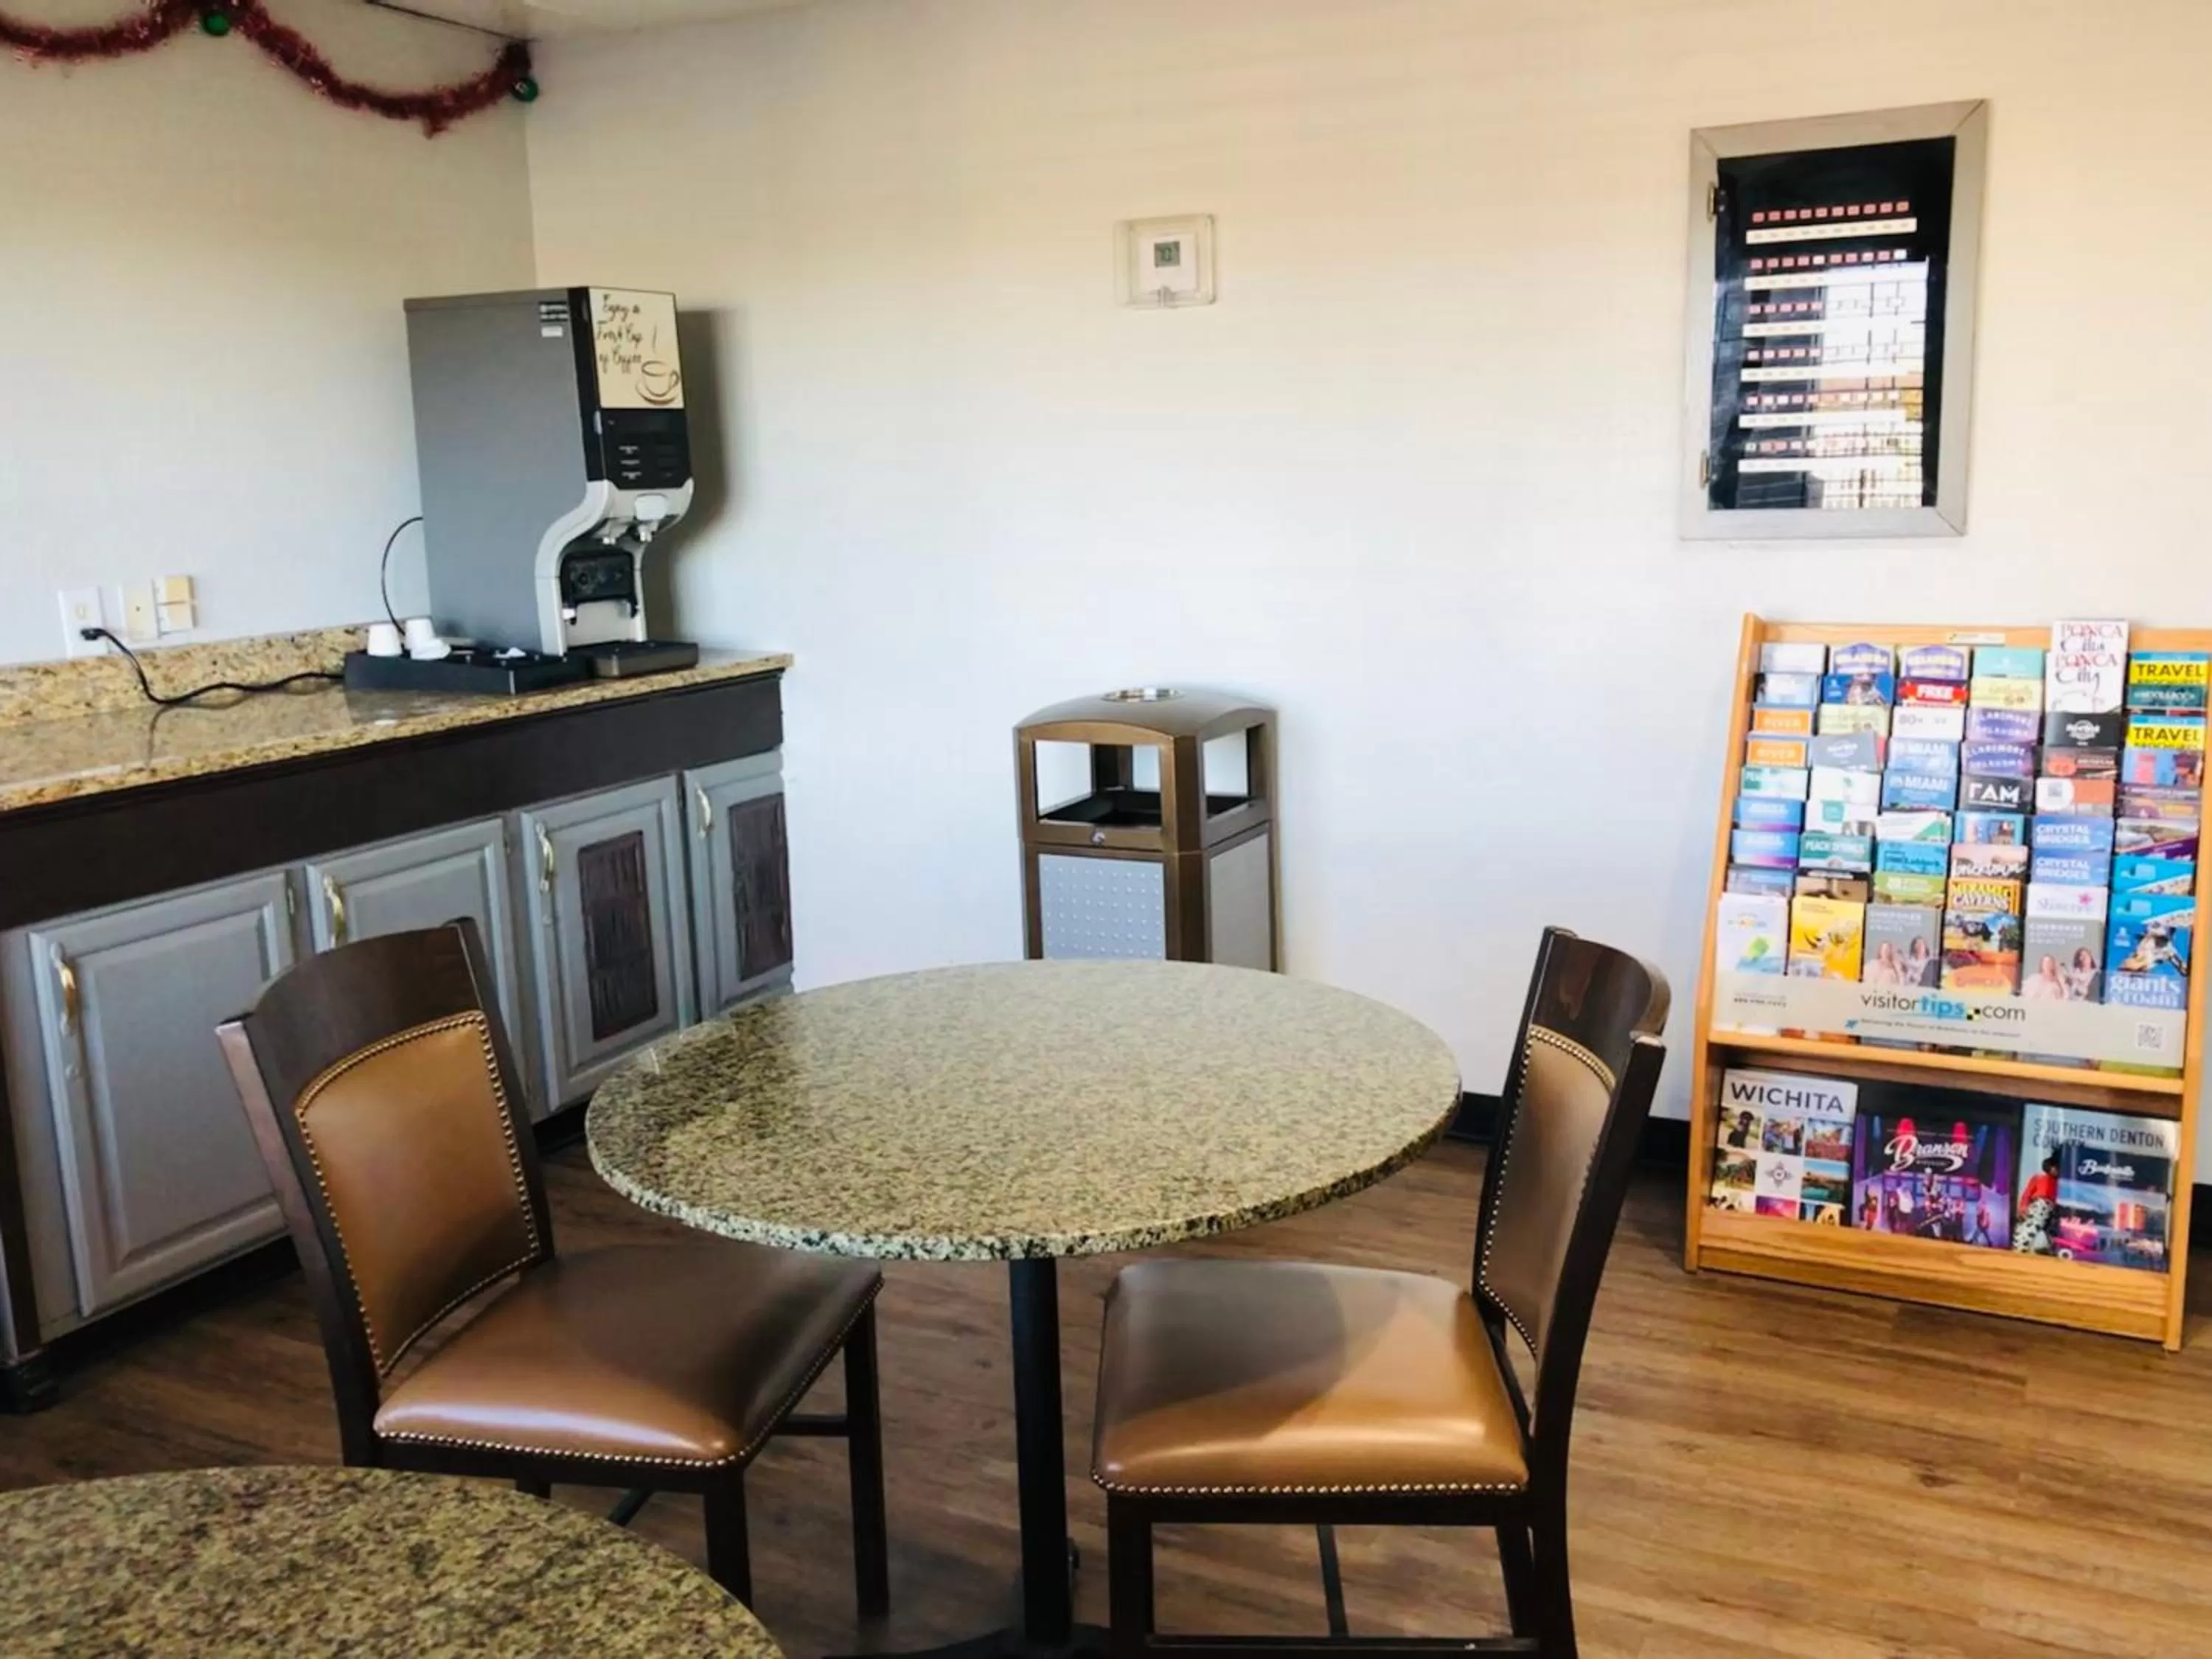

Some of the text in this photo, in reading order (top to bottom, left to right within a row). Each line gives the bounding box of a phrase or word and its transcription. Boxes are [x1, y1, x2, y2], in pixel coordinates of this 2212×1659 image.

[2060, 624, 2124, 638] PONCA
[2054, 653, 2118, 667] PONCA
[2137, 663, 2203, 678] TRAVEL
[2054, 667, 2101, 695] City
[1918, 685, 1953, 700] FREE
[2134, 726, 2200, 742] TRAVEL
[1904, 776, 1948, 791] MIAMI
[2110, 975, 2181, 995] giants
[1731, 1081, 1844, 1113] WICHITA
[2034, 1119, 2166, 1148] SOUTHERN DENTON
[1883, 1133, 1969, 1172] Branson
